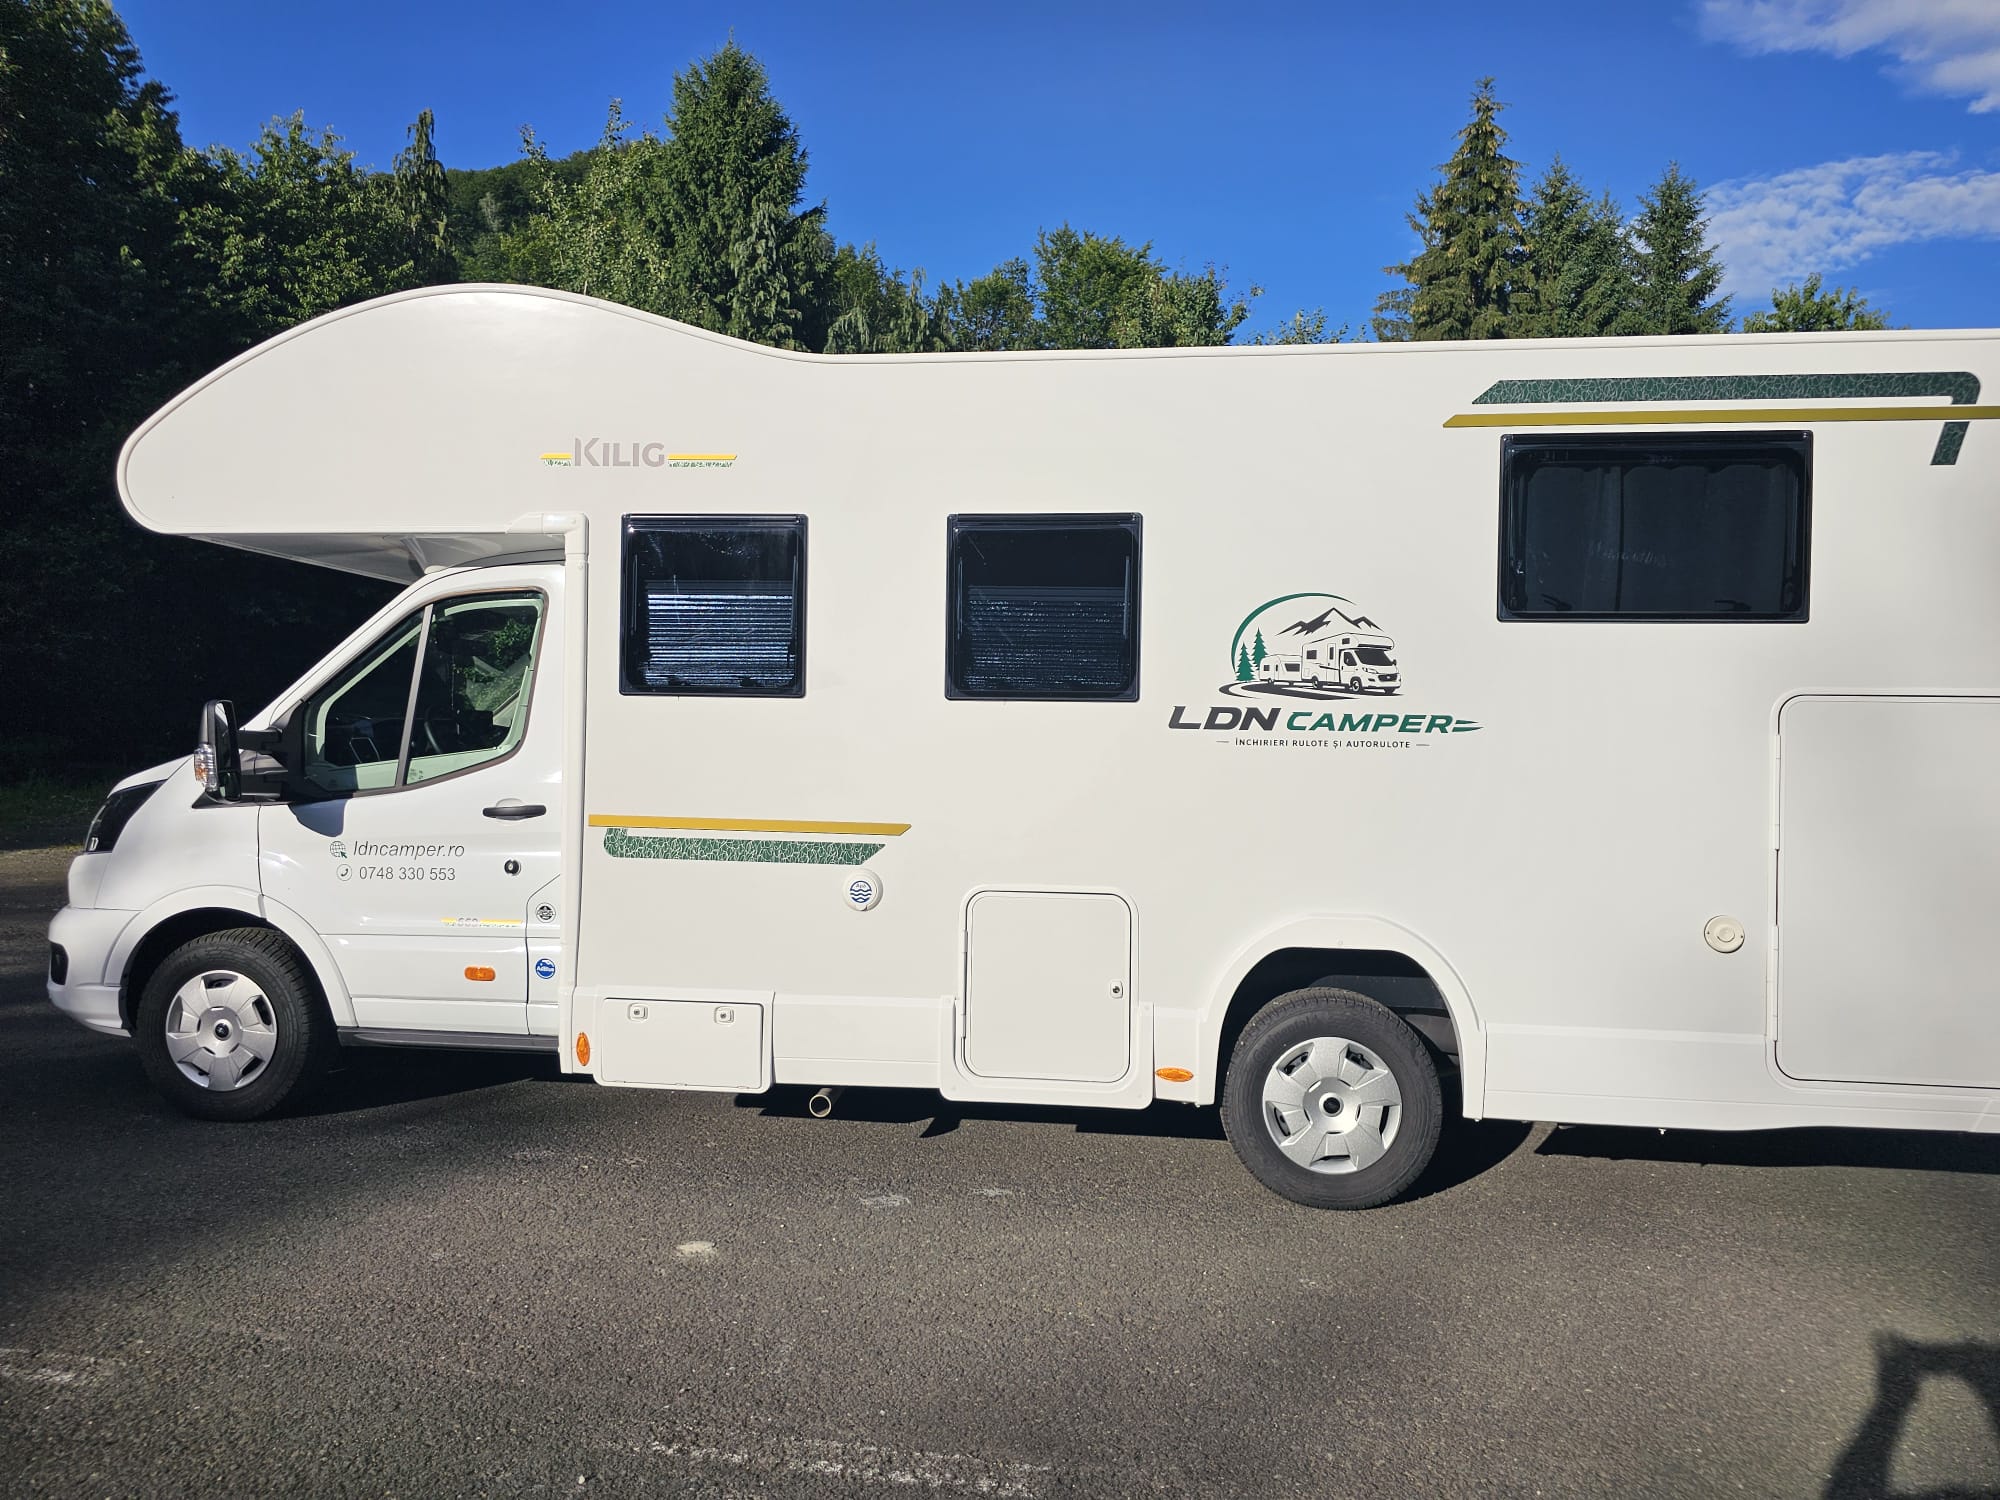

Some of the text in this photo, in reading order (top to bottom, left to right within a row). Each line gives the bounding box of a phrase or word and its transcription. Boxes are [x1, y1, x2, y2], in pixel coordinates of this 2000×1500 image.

[574, 437, 665, 467] KILIG
[1168, 705, 1454, 734] LDN CAMPER
[1292, 739, 1329, 748] RULOTE
[1346, 740, 1411, 749] AUTORULOTE
[353, 840, 465, 861] ldncamper.ro
[359, 866, 456, 881] 0748 330 553
